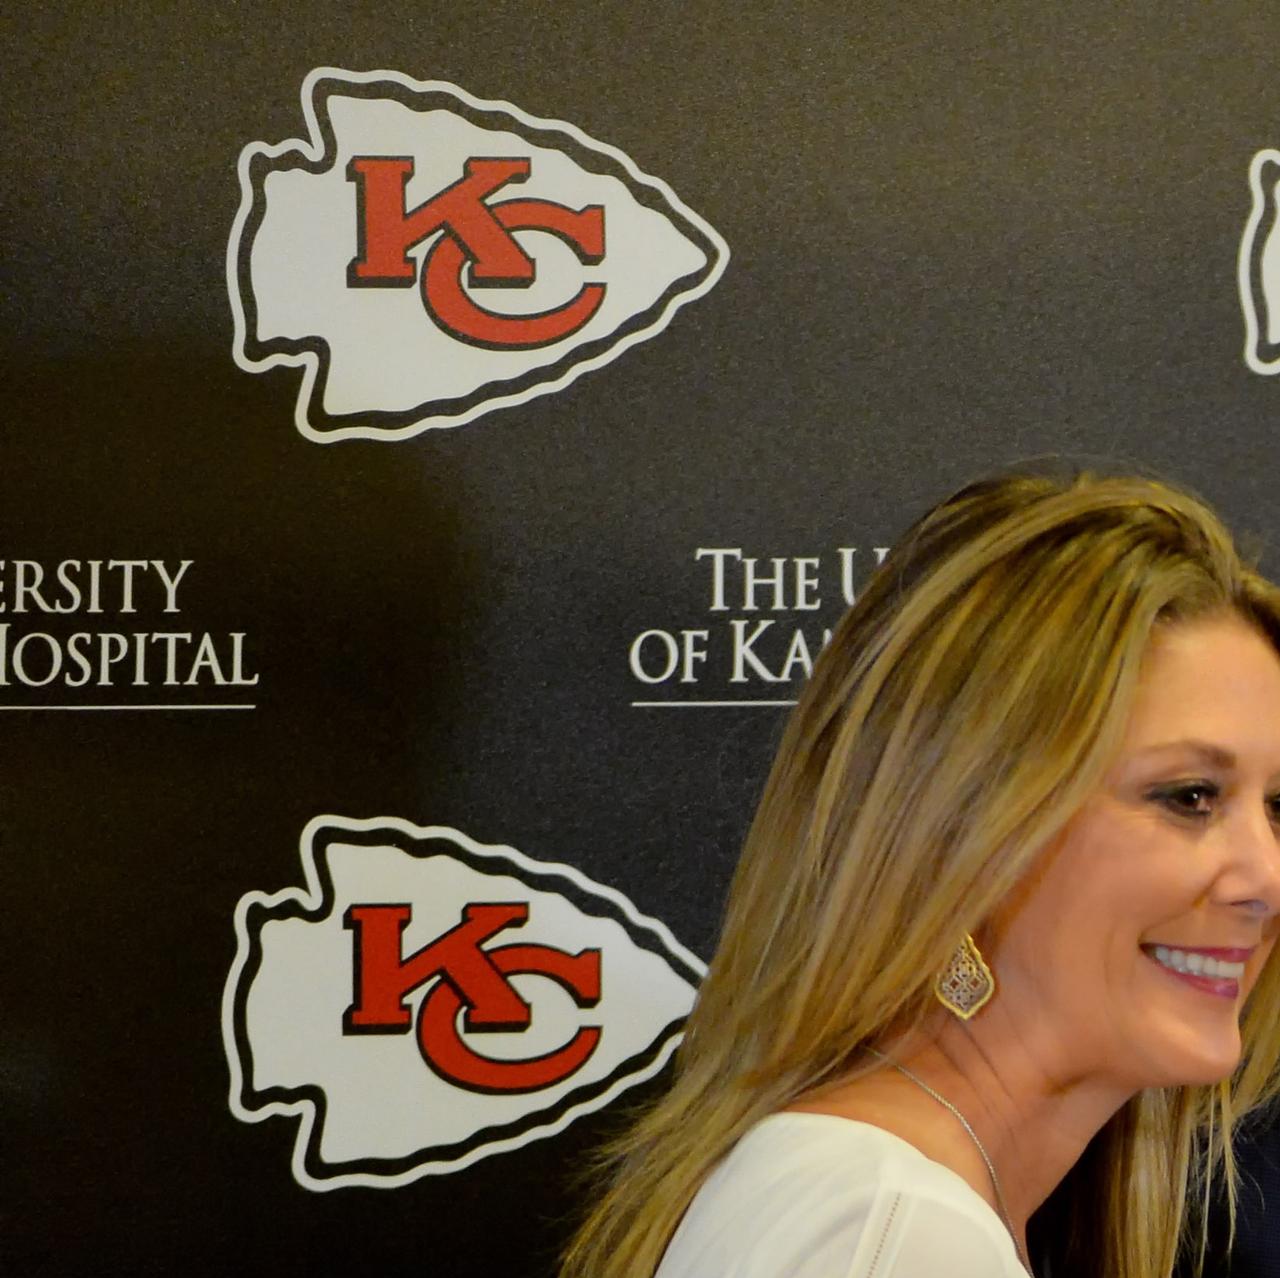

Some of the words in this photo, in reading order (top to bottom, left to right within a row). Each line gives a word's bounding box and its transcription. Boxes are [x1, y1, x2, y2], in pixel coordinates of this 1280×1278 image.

[346, 155, 606, 351] KC
[695, 547, 822, 611] THE
[342, 902, 602, 1095] KC
